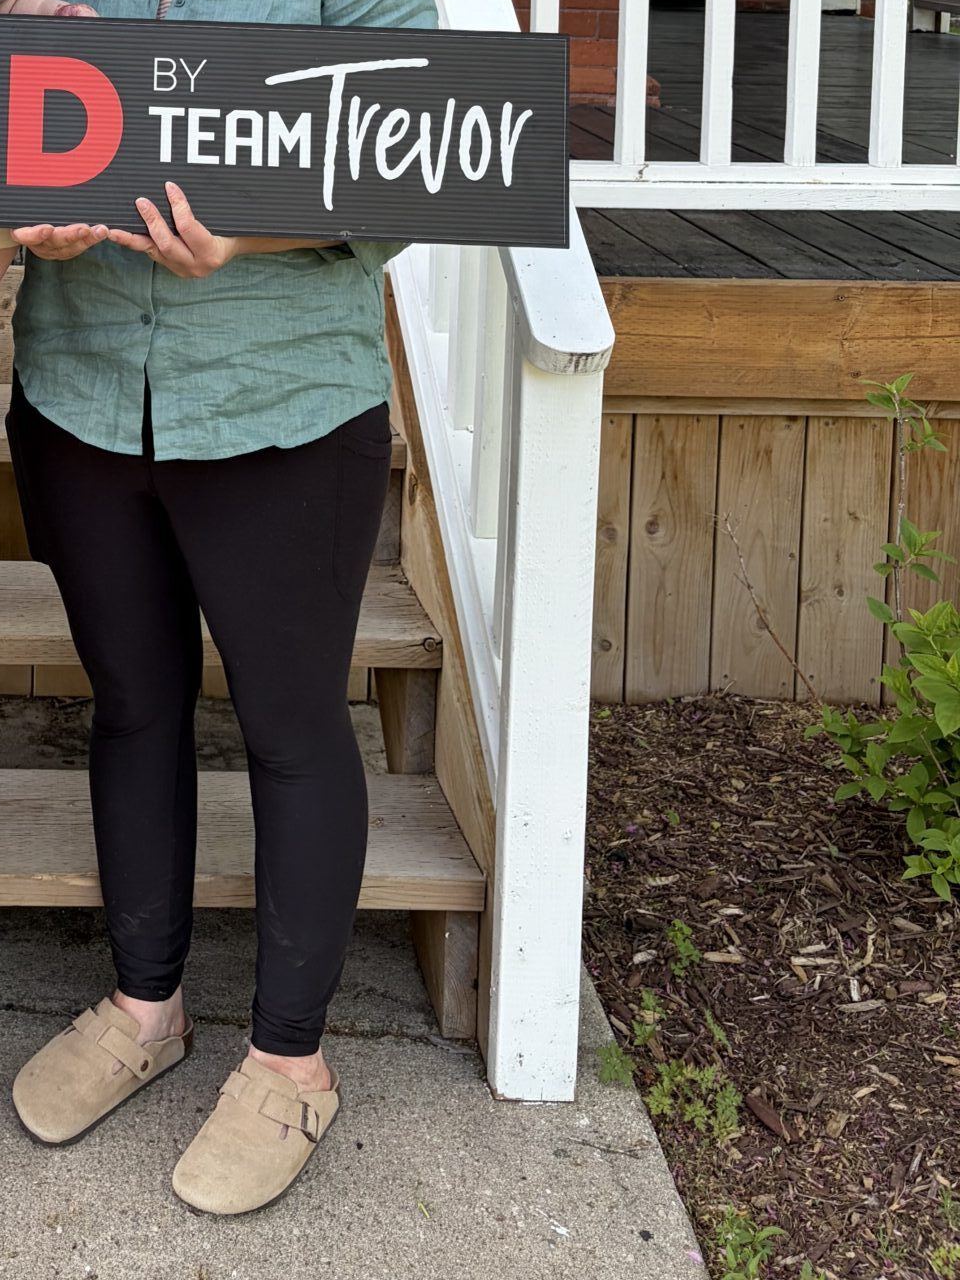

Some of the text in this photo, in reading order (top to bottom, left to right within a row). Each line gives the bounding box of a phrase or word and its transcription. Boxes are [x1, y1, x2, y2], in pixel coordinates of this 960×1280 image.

[153, 57, 208, 93] BY
[148, 57, 534, 212] TEAM Trevor
